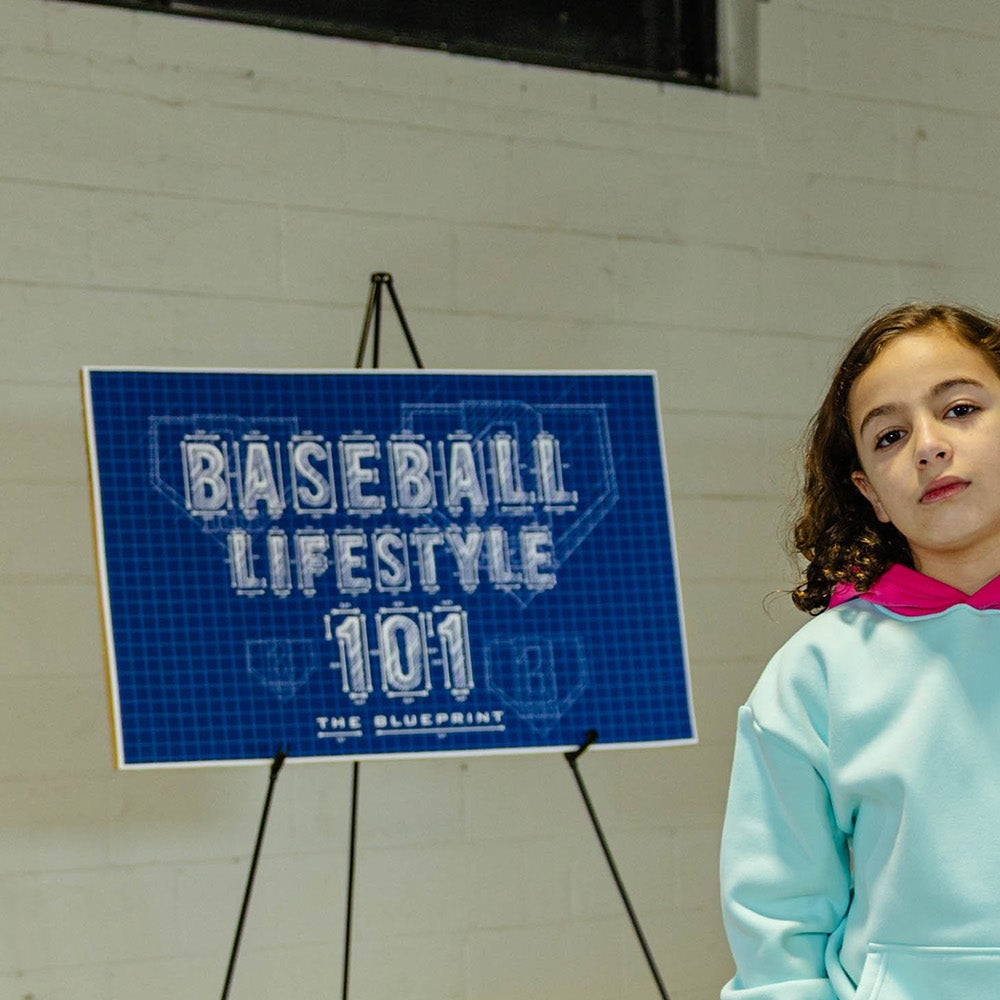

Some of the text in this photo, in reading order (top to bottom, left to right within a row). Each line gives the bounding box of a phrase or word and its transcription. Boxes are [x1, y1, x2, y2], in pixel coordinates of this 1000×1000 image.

[183, 433, 579, 516] BASEBALL
[229, 527, 557, 595] LIFESTYLE
[329, 606, 474, 700] 101
[316, 711, 504, 730] THE BLUEPRINT
